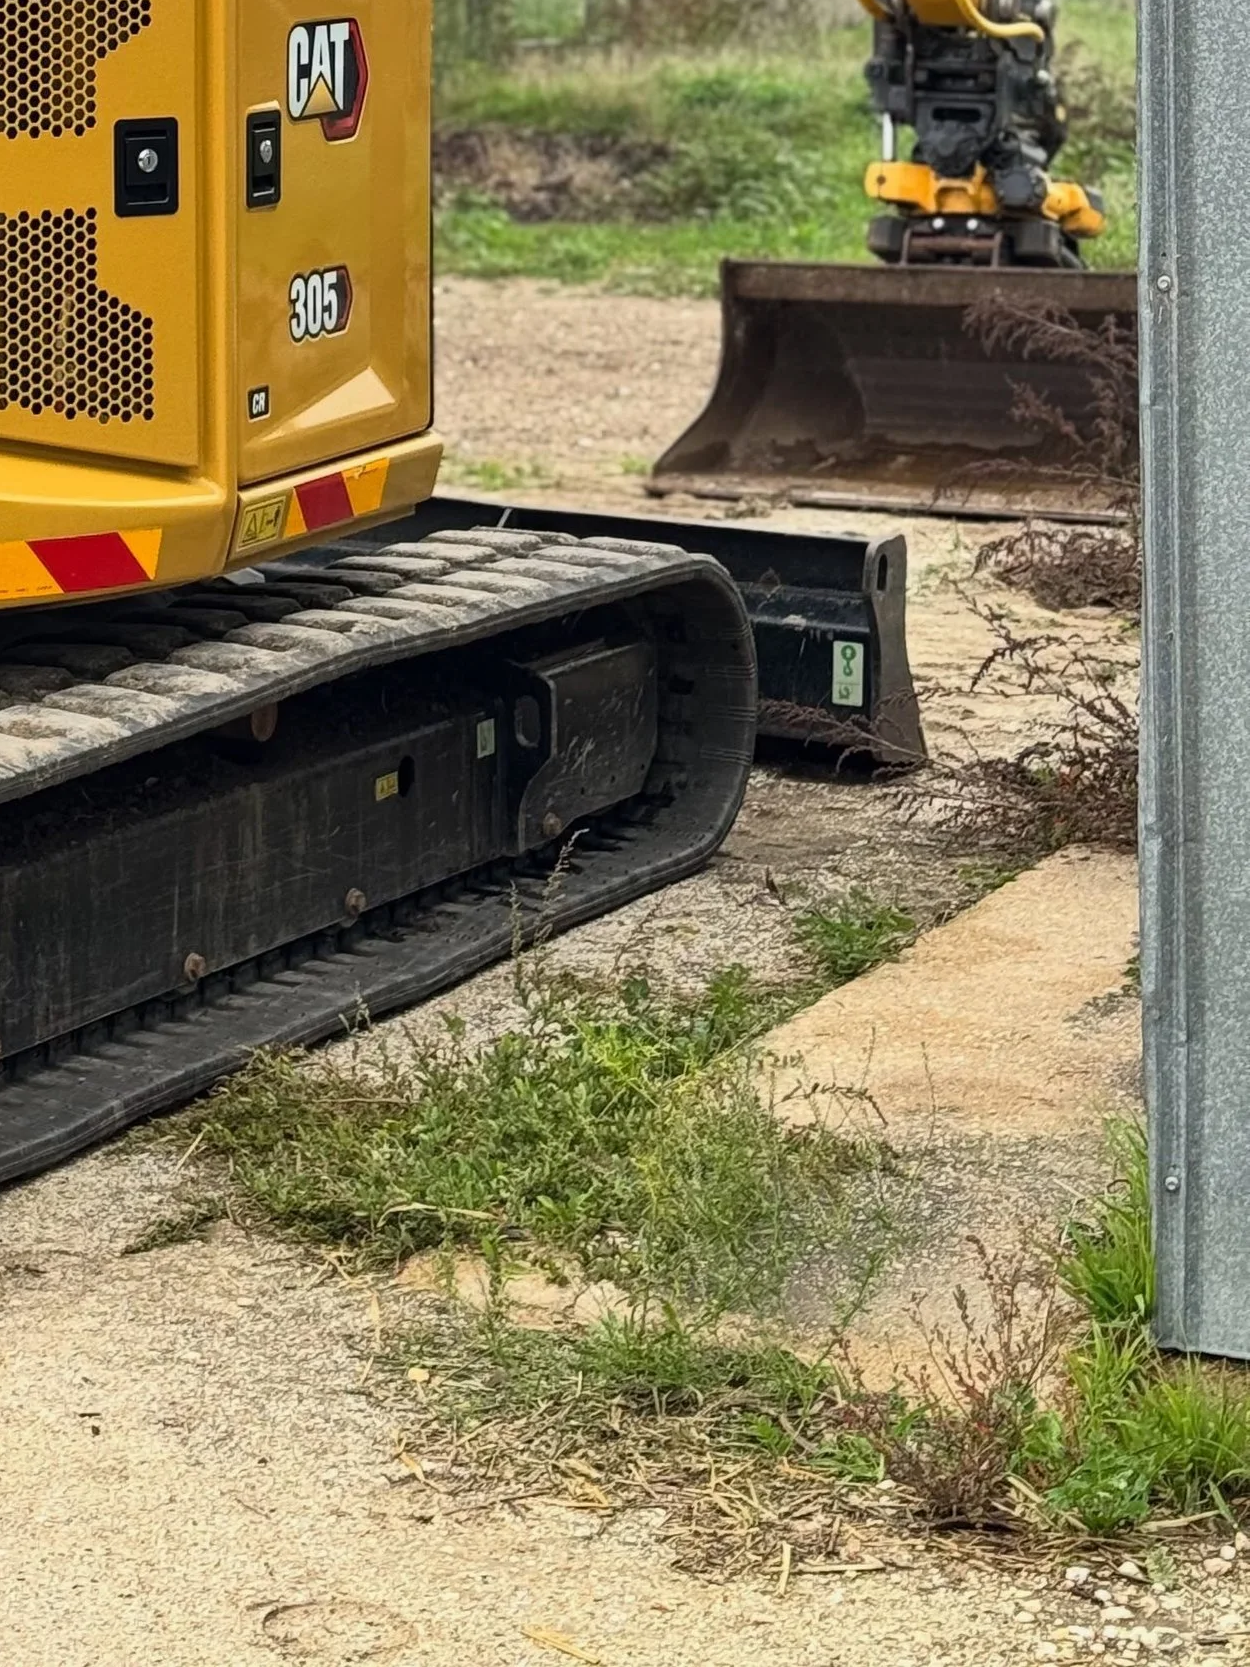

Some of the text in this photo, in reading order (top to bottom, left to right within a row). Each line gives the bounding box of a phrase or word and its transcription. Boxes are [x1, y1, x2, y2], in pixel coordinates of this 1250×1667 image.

[288, 22, 349, 118] CAT
[290, 270, 340, 340] 305
[252, 392, 265, 415] CR
